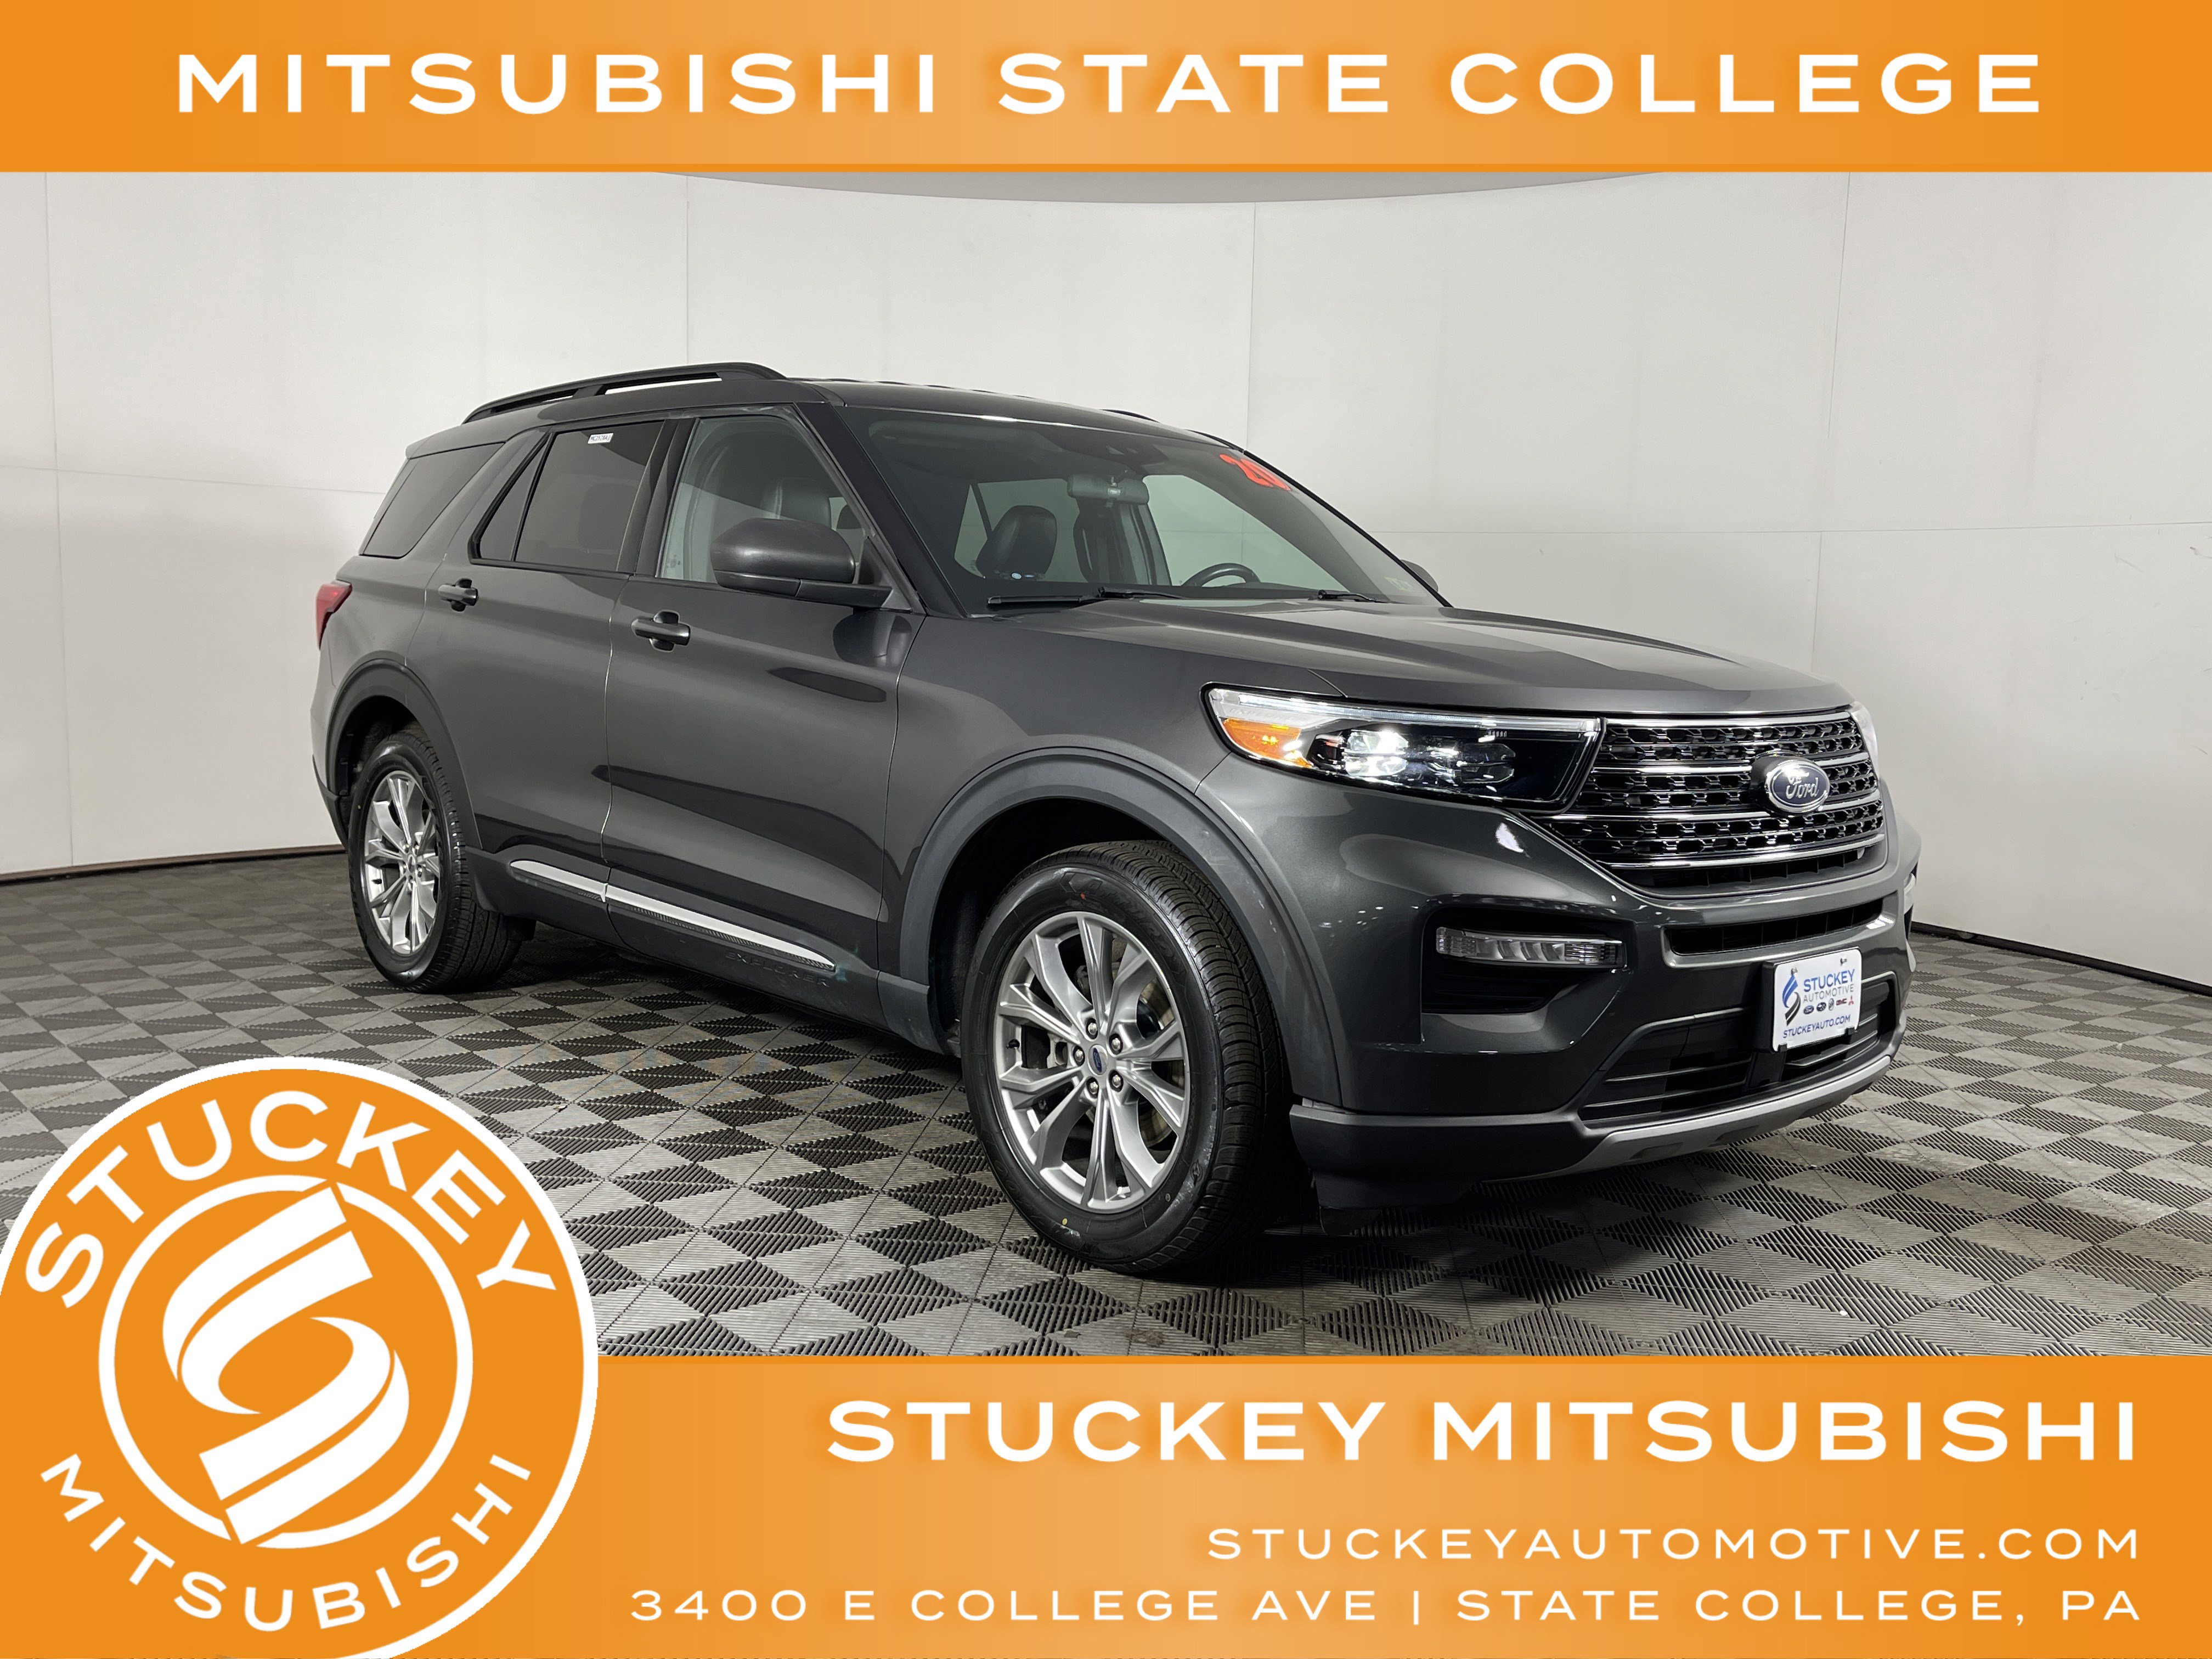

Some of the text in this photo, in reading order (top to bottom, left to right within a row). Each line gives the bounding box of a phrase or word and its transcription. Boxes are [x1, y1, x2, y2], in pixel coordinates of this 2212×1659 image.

[1785, 776, 1820, 800] Ford
[725, 951, 830, 987] EXPLORER
[1803, 968, 1855, 992] STUCKEY
[1803, 984, 1855, 1003] AUTOMOTIVE
[1782, 1014, 1851, 1038] STUCKEYAUTO.COM
